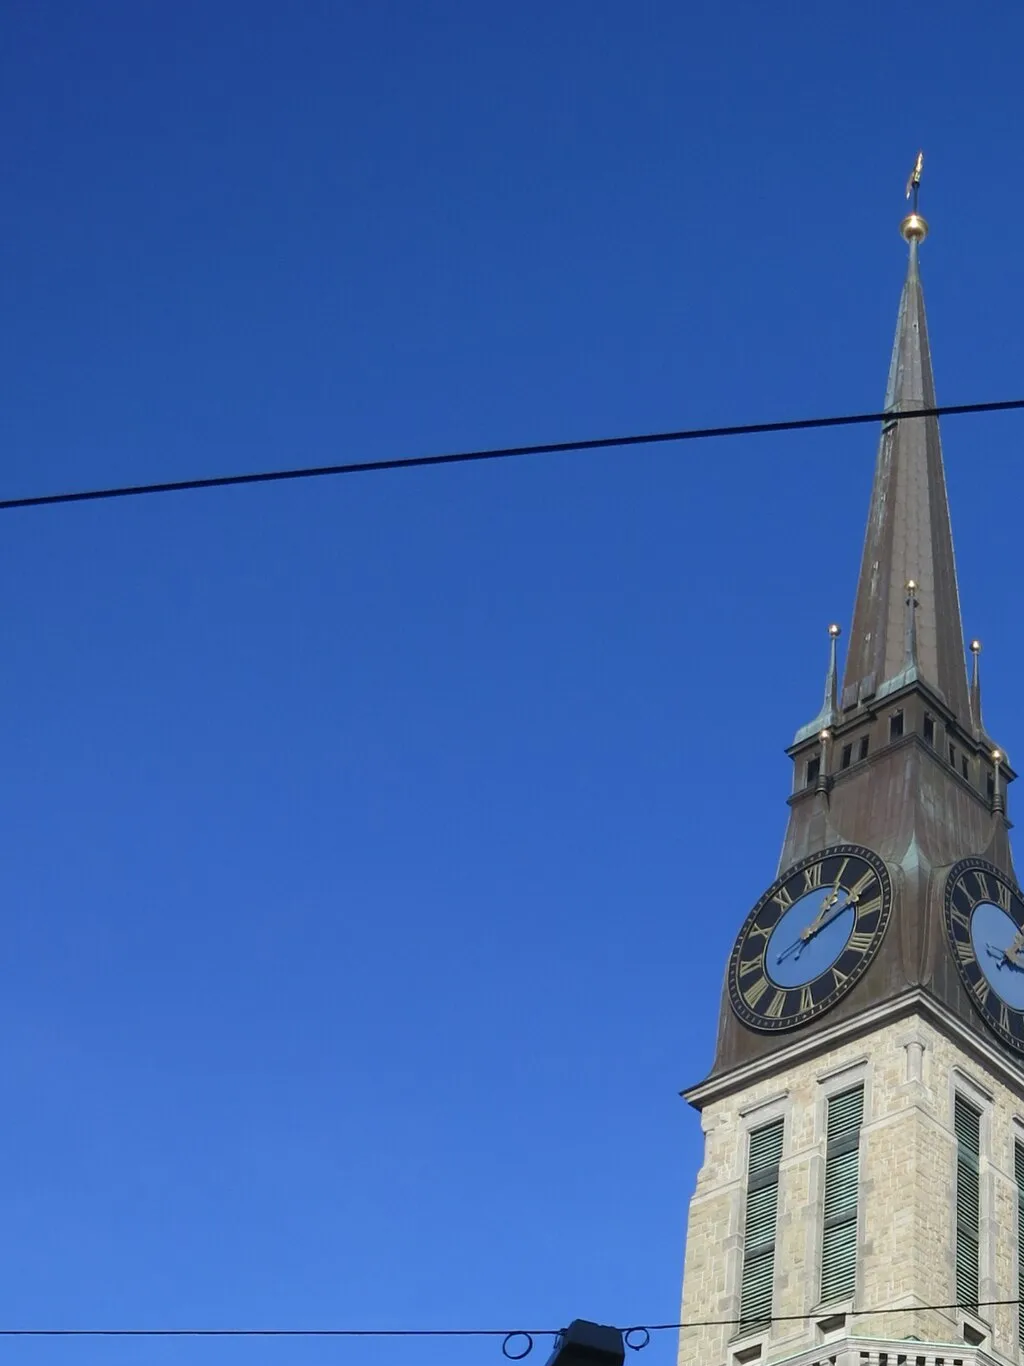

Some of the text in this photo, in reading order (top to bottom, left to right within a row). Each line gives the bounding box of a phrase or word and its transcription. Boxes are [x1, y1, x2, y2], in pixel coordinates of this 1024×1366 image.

[803, 862, 823, 893] XII
[773, 886, 793, 913] XI
[957, 877, 975, 908] X
[995, 879, 1012, 913] XII
[857, 895, 883, 920] III
[749, 923, 774, 939] X
[848, 931, 876, 954] IIII
[831, 967, 849, 989] V
[743, 976, 770, 1009] VIII
[763, 990, 787, 1018] VII
[800, 986, 815, 1012] VI
